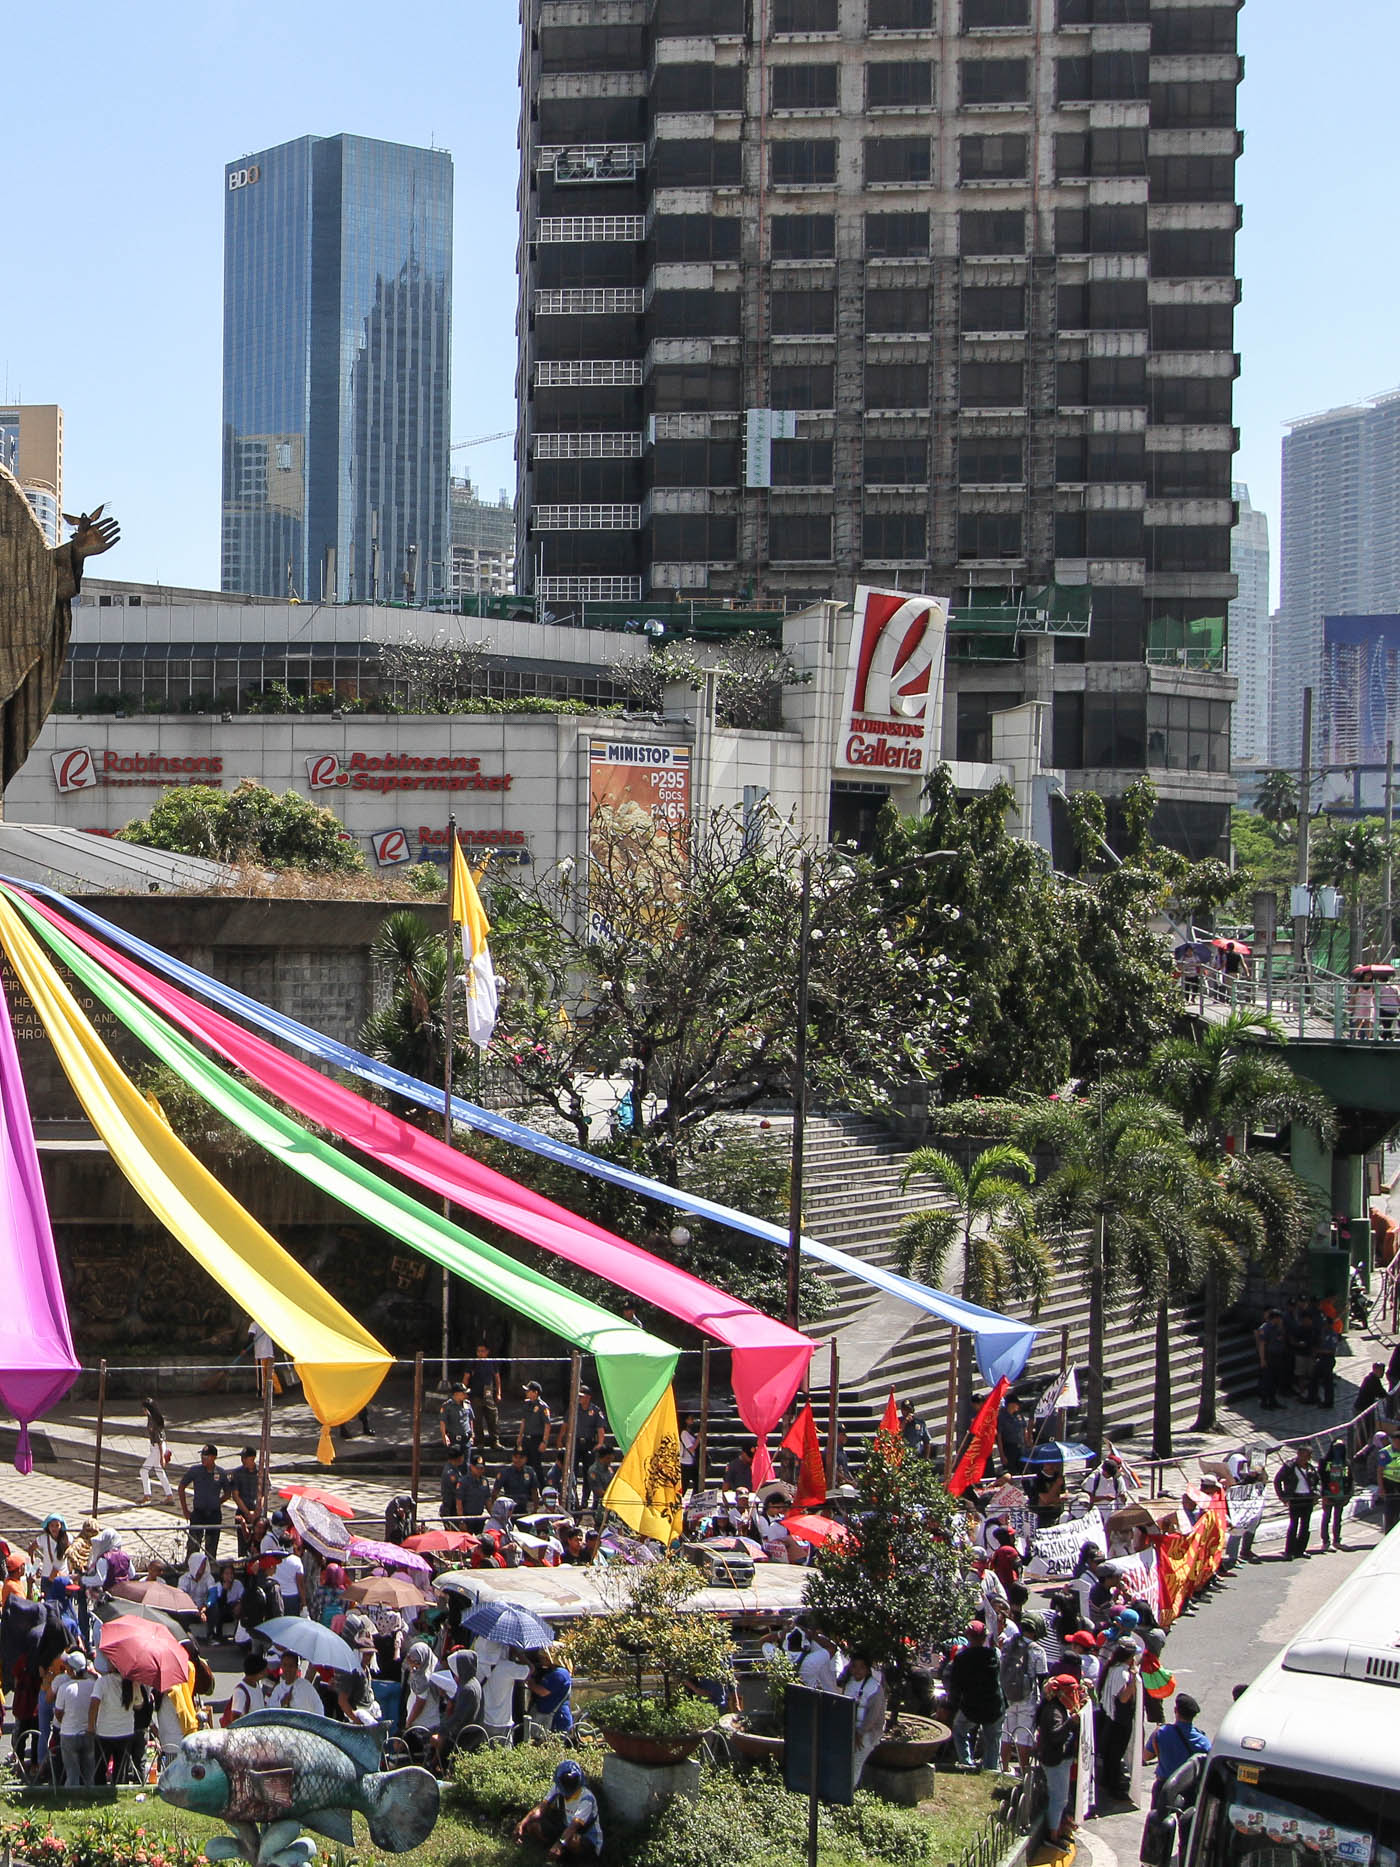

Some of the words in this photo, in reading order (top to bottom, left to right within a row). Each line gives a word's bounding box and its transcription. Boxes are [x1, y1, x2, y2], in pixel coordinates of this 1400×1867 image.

[228, 165, 260, 191] BDO
[850, 718, 925, 739] ROBINSONS
[103, 751, 223, 774] Robinsons
[350, 753, 481, 771] Robinsons
[608, 745, 670, 764] MINISTOP
[846, 734, 922, 770] Galleria
[352, 772, 514, 794] Supermarket
[650, 771, 685, 789] P295
[658, 788, 685, 802] 6pcs.
